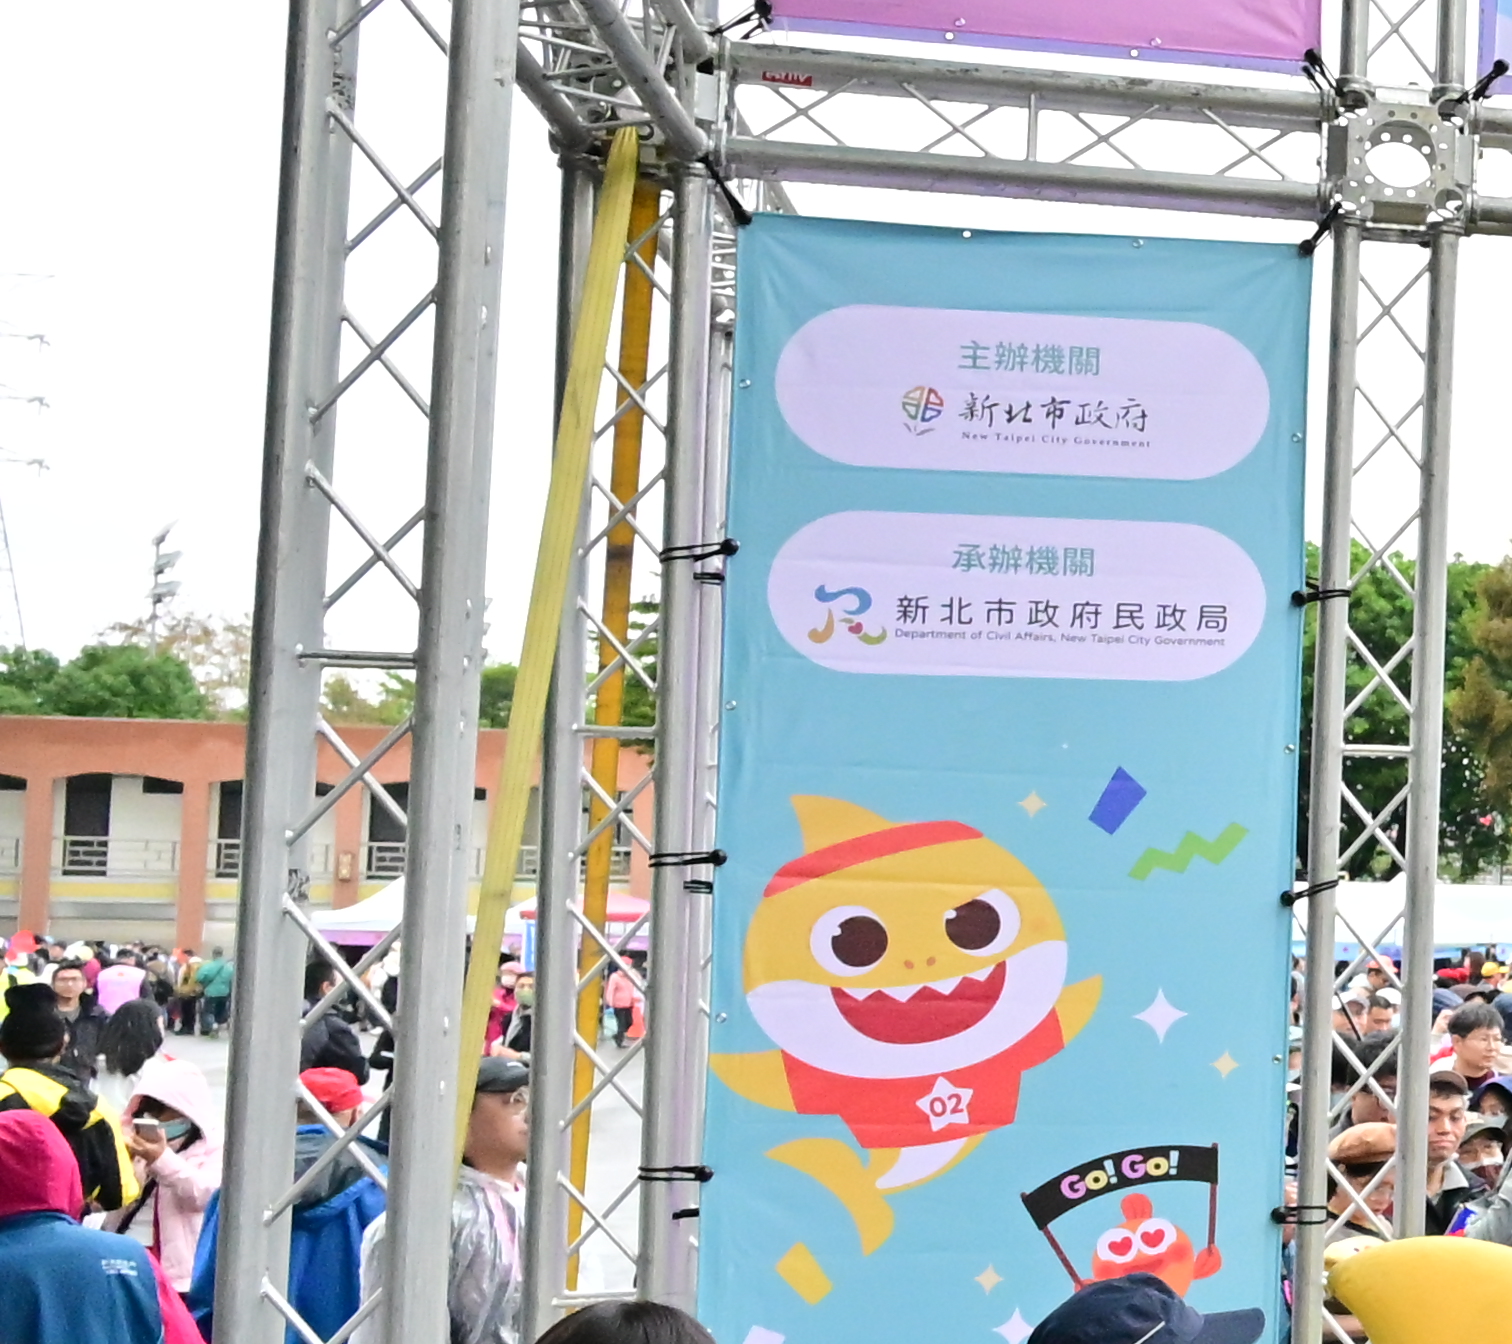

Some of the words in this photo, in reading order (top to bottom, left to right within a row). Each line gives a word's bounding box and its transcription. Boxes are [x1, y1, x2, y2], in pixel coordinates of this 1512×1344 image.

[958, 340, 1102, 377] 主辦機關
[958, 391, 1149, 434] 新北市政府
[961, 431, 988, 440] New
[995, 433, 1036, 444] Taipei
[1041, 435, 1068, 445] City
[1073, 436, 1151, 448] Government
[952, 544, 1095, 578] 承辦機關
[895, 595, 1229, 635] 新北市政府民政局
[895, 628, 966, 641] Department
[970, 629, 983, 640] of
[986, 630, 1011, 640] Civil
[1061, 633, 1087, 643] New
[1091, 633, 1125, 645] Taipei
[1128, 635, 1151, 646] City
[1154, 635, 1226, 647] Government
[928, 1092, 967, 1118] 02
[1060, 1152, 1118, 1200] Go!
[1121, 1149, 1179, 1182] Go!
